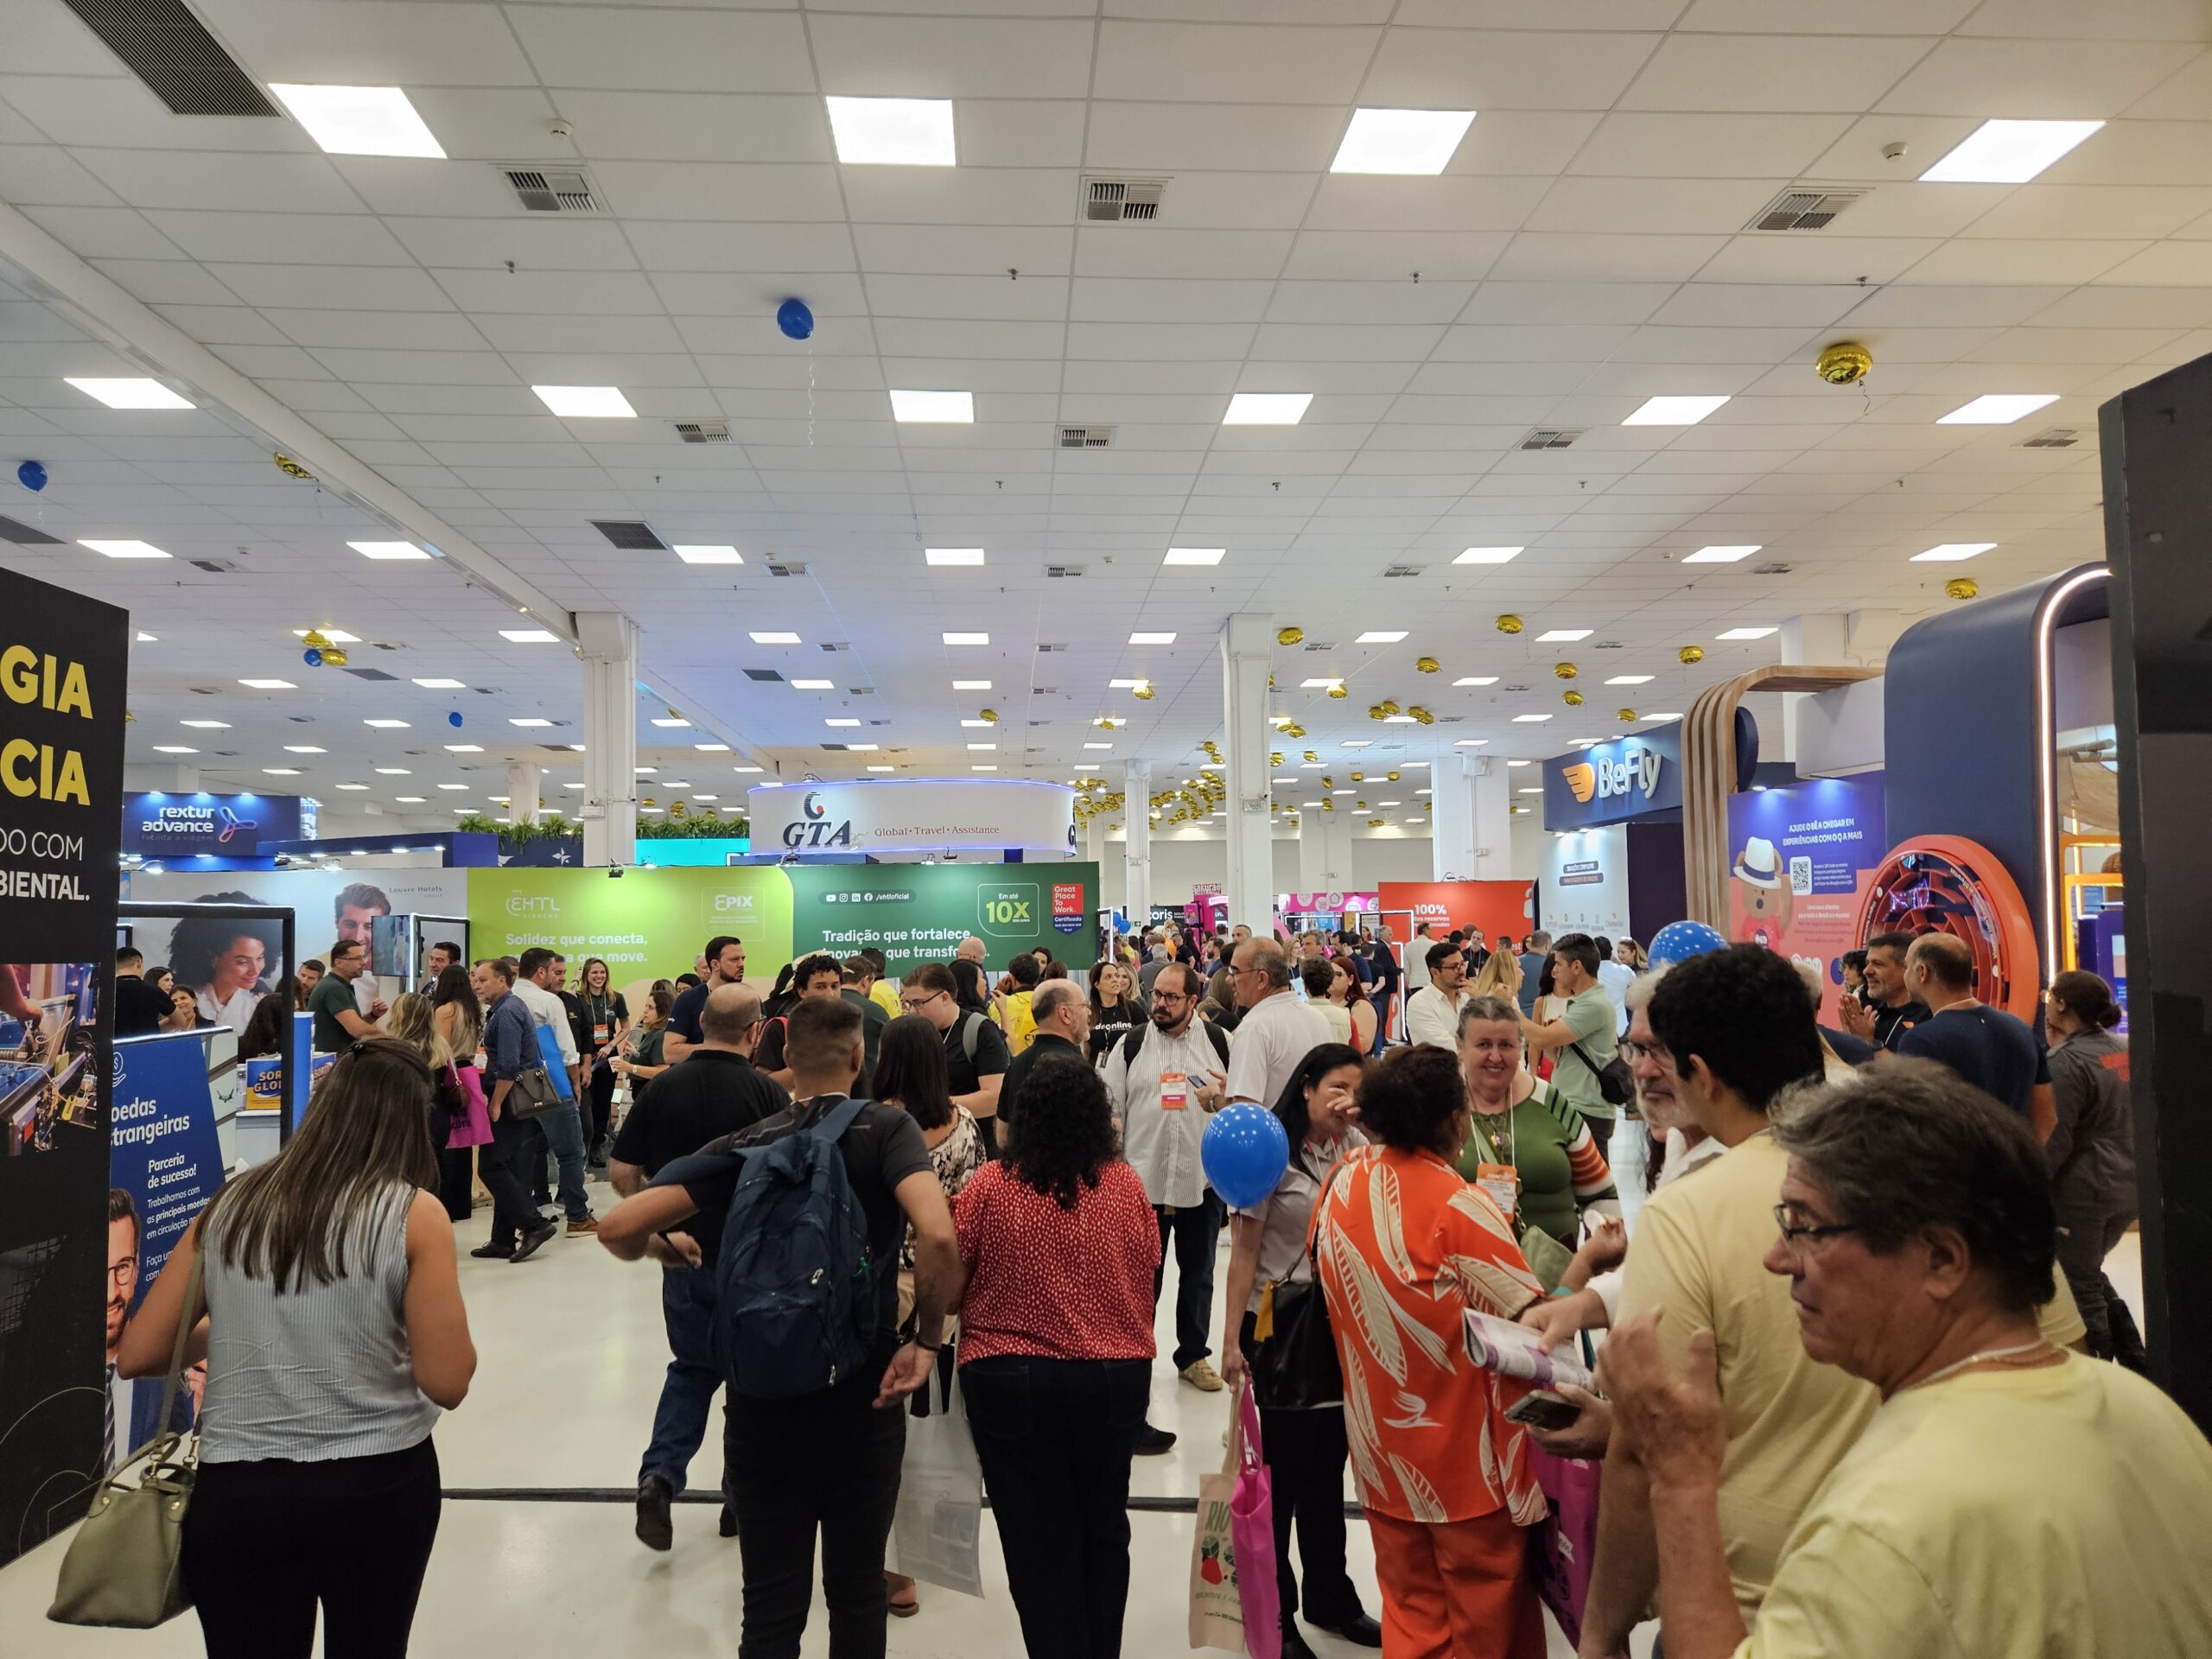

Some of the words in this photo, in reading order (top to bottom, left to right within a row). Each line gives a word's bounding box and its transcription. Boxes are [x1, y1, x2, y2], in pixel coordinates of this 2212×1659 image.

[0, 645, 93, 720] GIA
[0, 738, 91, 806] CIA
[1598, 747, 1662, 798] BeFly
[159, 805, 215, 819] rextur
[142, 818, 214, 833] advance
[1789, 823, 1805, 833] AJUDE
[1806, 823, 1810, 831] O
[1822, 818, 1845, 829] CHEGAR
[1846, 817, 1854, 826] EM
[782, 820, 850, 848] GTA
[874, 827, 907, 836] Global
[914, 826, 945, 836] Travel
[952, 825, 1001, 834] Assistance
[1783, 835, 1818, 846] EXPERIÊNCIAS
[1818, 833, 1832, 843] COM
[1832, 833, 1837, 842] O
[1842, 832, 1847, 841] A
[1848, 830, 1863, 840] MAIS
[31, 830, 84, 861] COM
[875, 893, 910, 901] /ehtloficial
[1414, 904, 1446, 915] 100%
[505, 933, 556, 945] Solidez
[560, 935, 585, 947] que
[589, 932, 648, 945] conecta,
[823, 929, 880, 944] Tradição
[883, 931, 908, 943] que
[607, 952, 647, 962] move.
[886, 948, 910, 961] que
[148, 1153, 185, 1173] Parceria
[148, 1175, 160, 1189] de
[161, 1164, 197, 1185] sucesso!
[147, 1190, 187, 1209] Trabalhamos
[188, 1186, 200, 1197] com
[147, 1215, 155, 1224] as
[156, 1204, 186, 1224] principais
[146, 1230, 157, 1239] em
[157, 1217, 188, 1235] circulação
[147, 1255, 162, 1267] Faça
[146, 1270, 160, 1281] com
